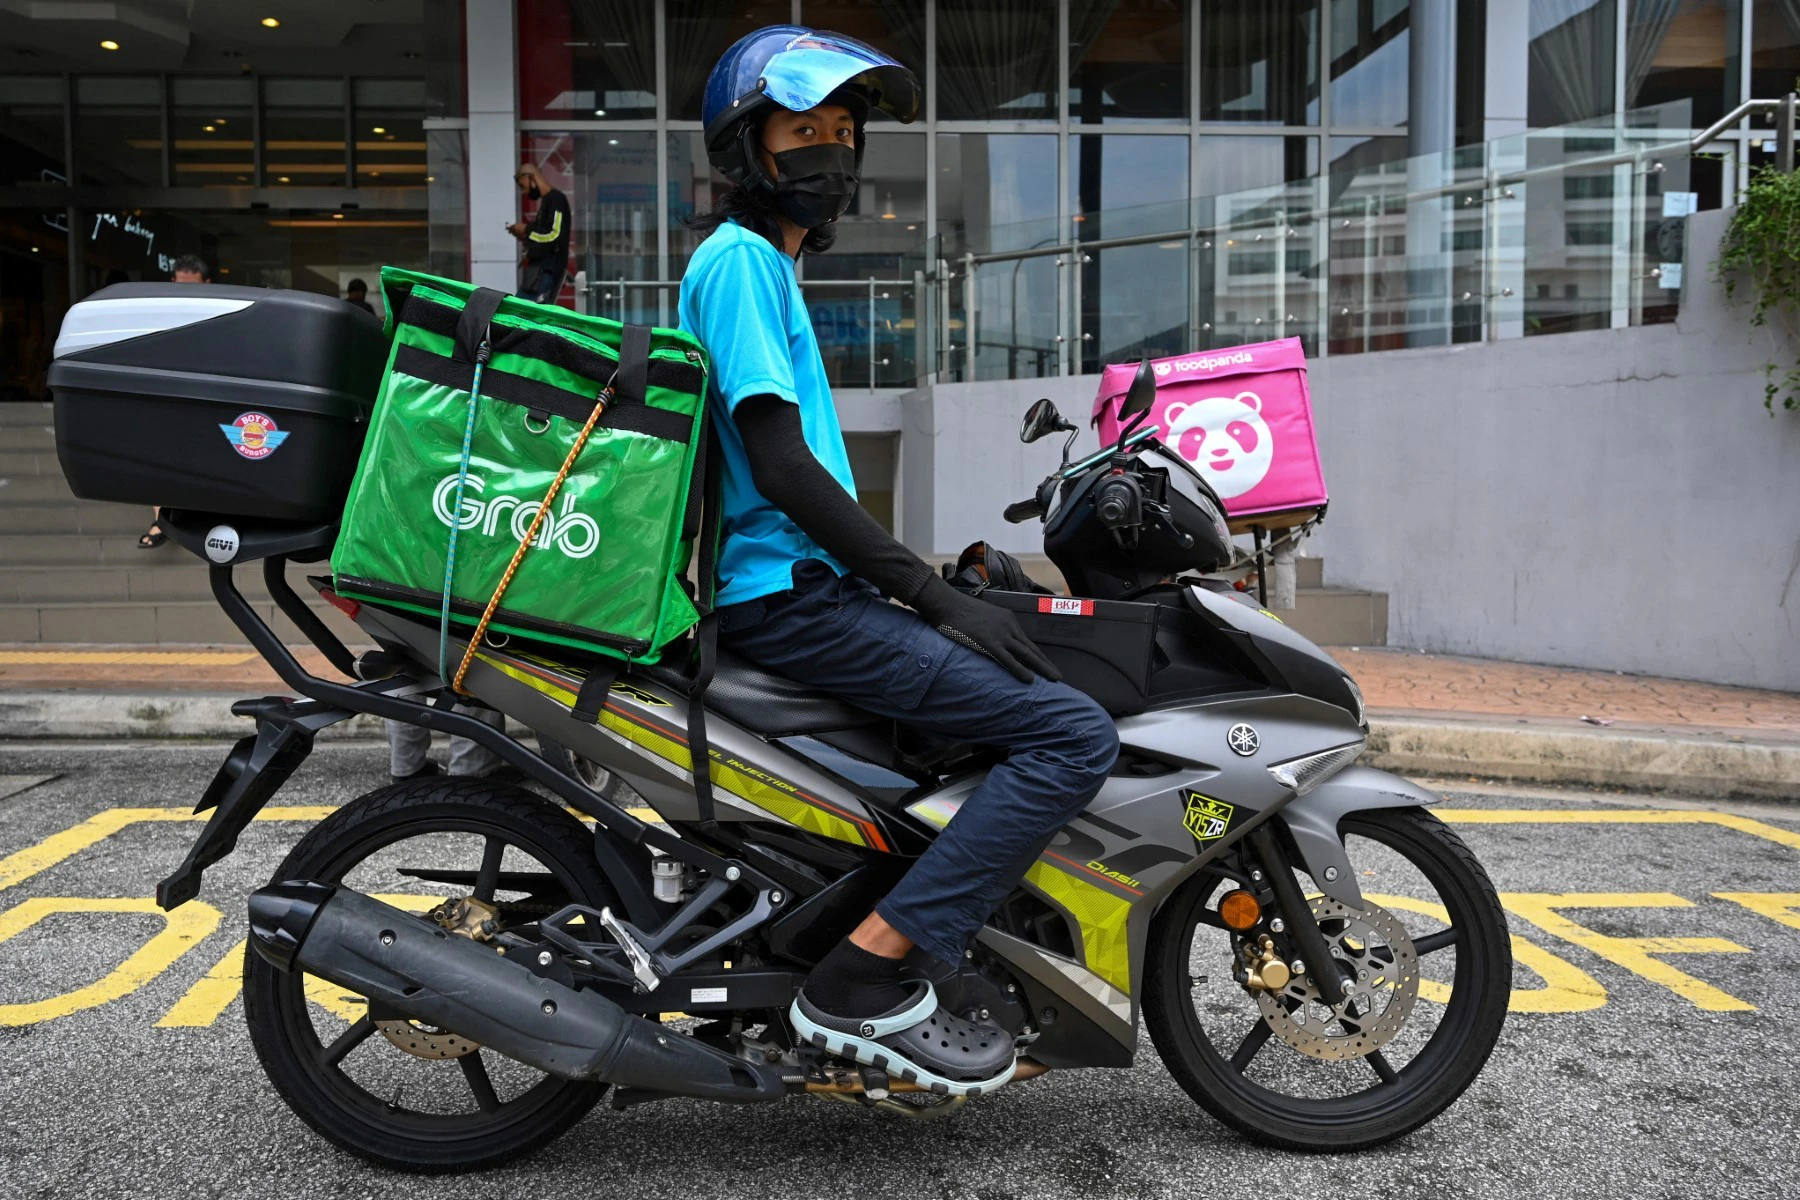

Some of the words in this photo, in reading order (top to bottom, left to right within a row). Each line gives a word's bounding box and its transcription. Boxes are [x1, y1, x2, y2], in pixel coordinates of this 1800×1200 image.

[1174, 352, 1253, 372] foodpanda
[240, 414, 269, 426] BOY'S
[239, 445, 269, 456] BURGER
[432, 472, 600, 559] Grab
[1055, 600, 1080, 610] BKP
[727, 758, 798, 793] INJECTION
[1189, 810, 1226, 837] Y15ZR
